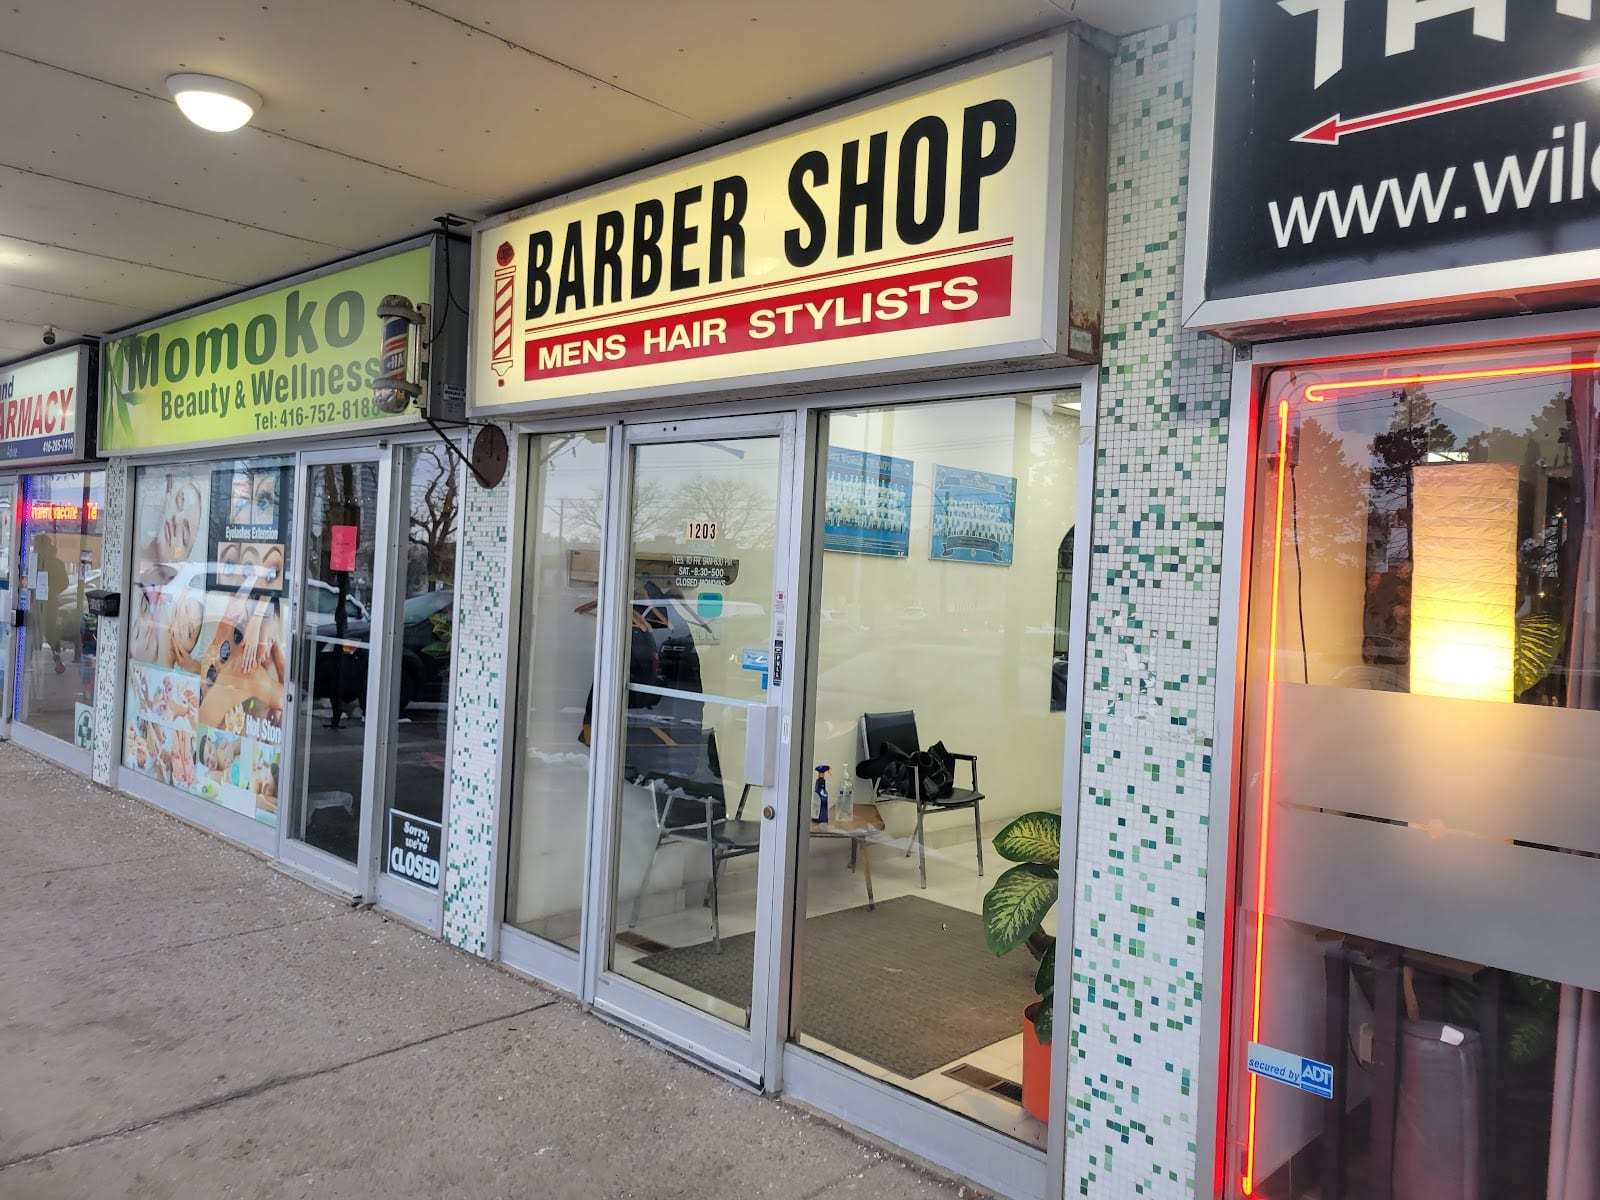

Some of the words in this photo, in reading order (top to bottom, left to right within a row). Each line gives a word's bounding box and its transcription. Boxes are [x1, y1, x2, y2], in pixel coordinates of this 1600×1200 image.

[1268, 121, 1600, 248] www.wil
[525, 175, 748, 320] BARBER
[784, 98, 1018, 268] SHOP
[538, 333, 627, 371] MENS
[643, 317, 728, 356] HAIR
[748, 275, 980, 339] STYLISTS
[127, 290, 365, 392] Momoko
[161, 382, 231, 421] Beauty
[235, 380, 246, 409] &
[251, 358, 380, 406] Wellness
[254, 412, 278, 431] Tel:
[280, 398, 380, 428] 416-752-8188
[225, 526, 251, 541] Eyelashes
[251, 527, 278, 540] Extension
[689, 523, 716, 539] 1203
[675, 578, 698, 587] CLOSED
[246, 713, 260, 738] Hot
[403, 821, 430, 843] Sorry,
[405, 837, 428, 853] we're
[391, 846, 440, 885] CLOSED
[1248, 1059, 1286, 1076] secured
[1288, 1069, 1300, 1081] by
[1302, 1065, 1331, 1085] ADT
